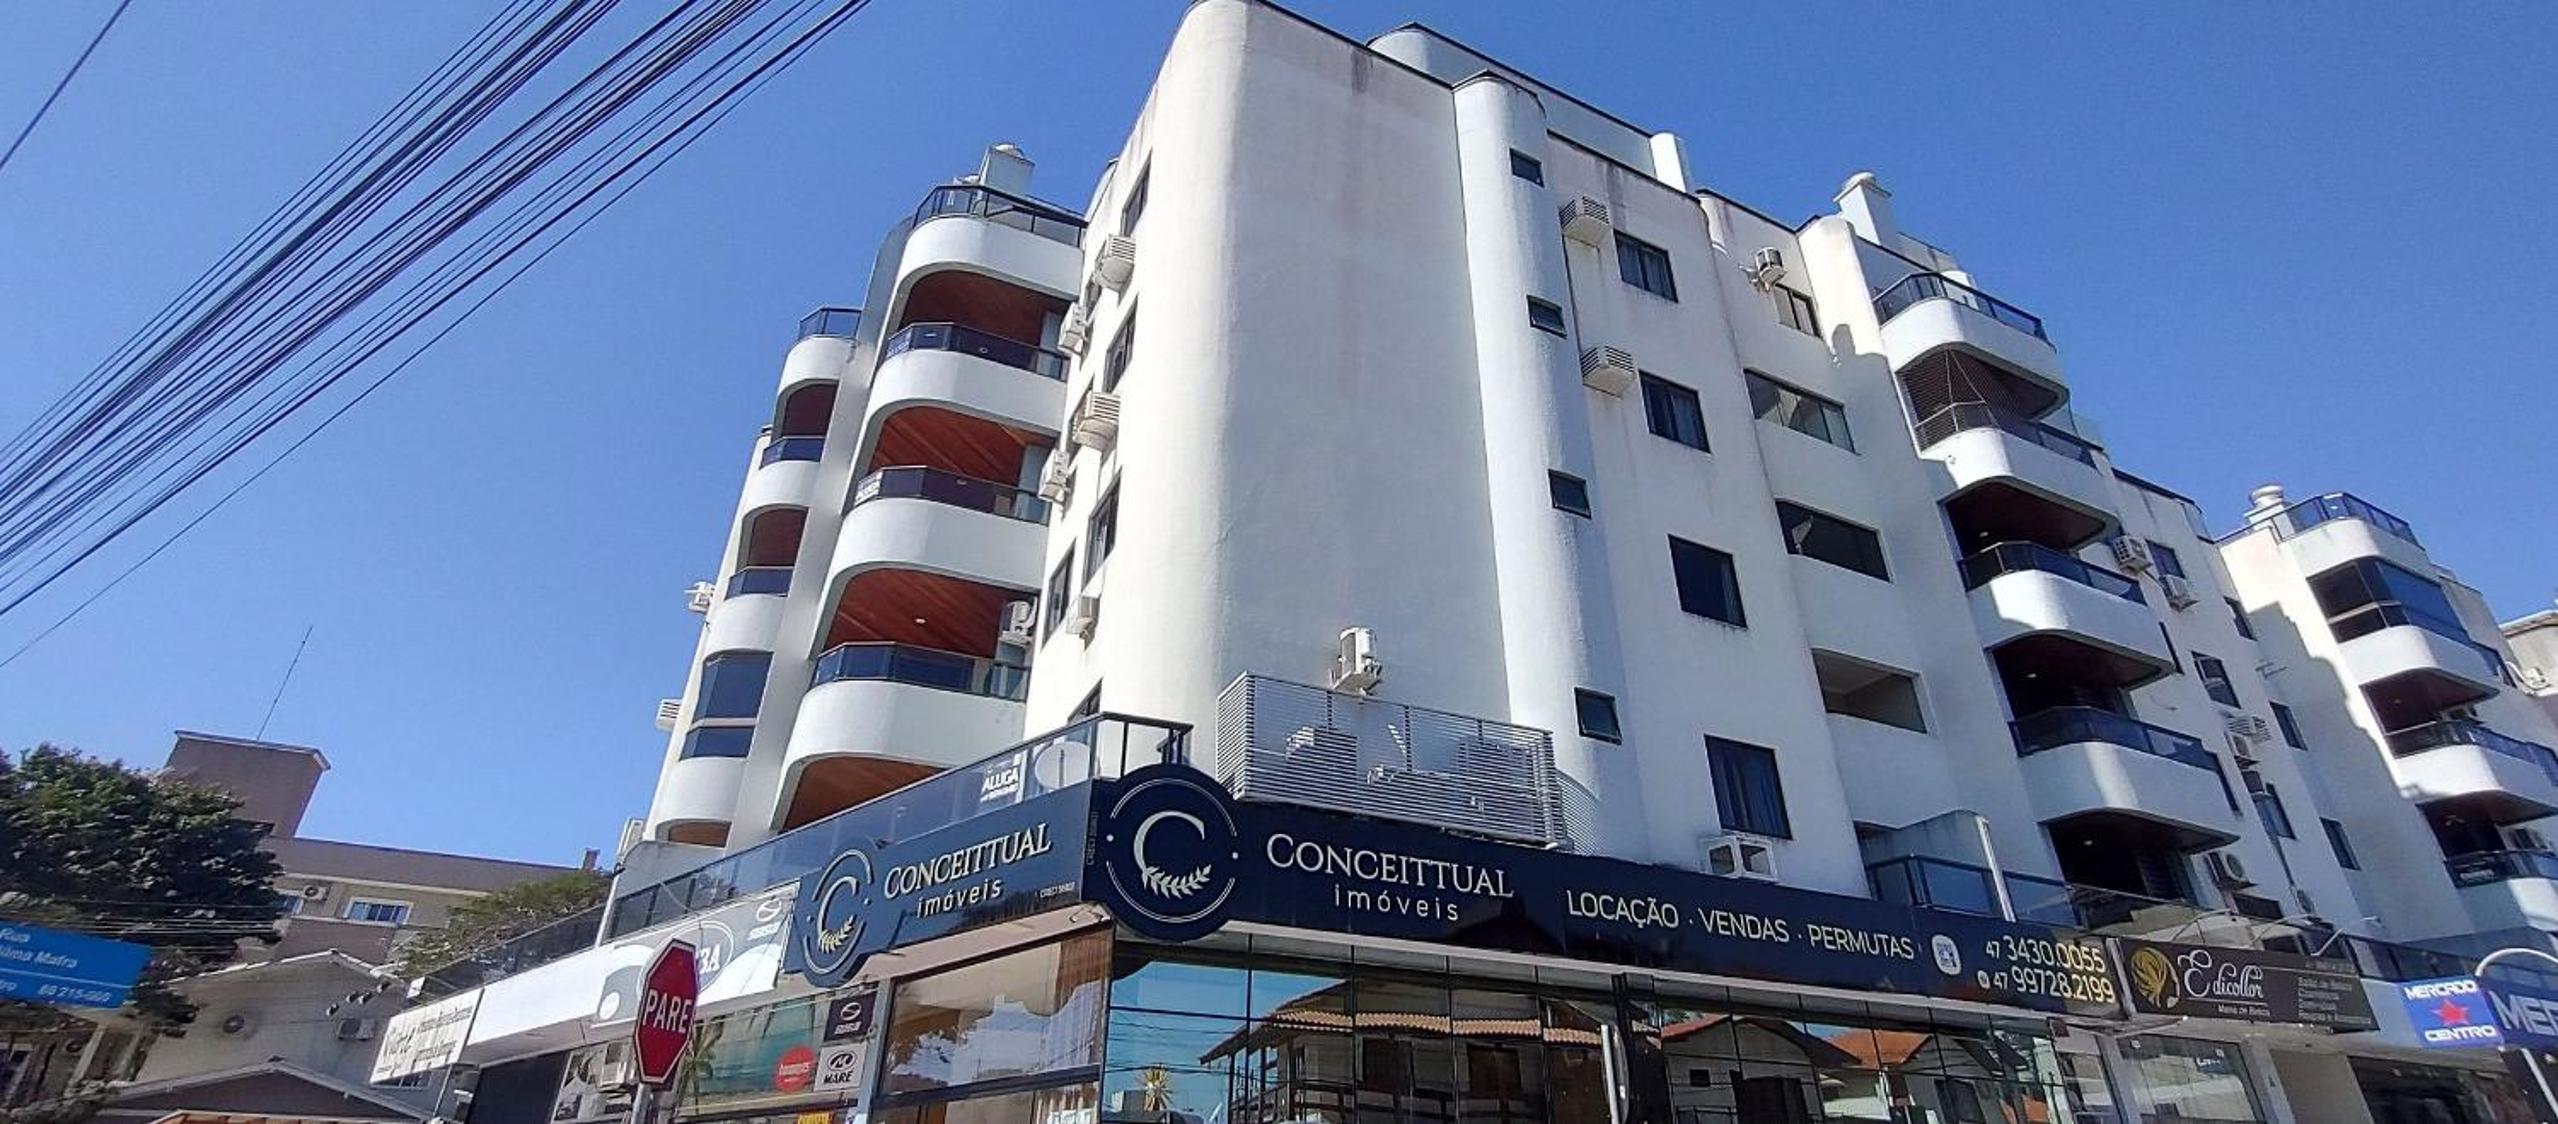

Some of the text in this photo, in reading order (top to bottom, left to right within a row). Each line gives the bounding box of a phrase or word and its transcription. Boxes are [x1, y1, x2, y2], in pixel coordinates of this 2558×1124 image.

[884, 822, 1052, 900] CONCEITTUAL
[1267, 833, 1515, 898] CONCEITTUAL
[917, 878, 1003, 918] imóveis
[1334, 883, 1460, 921] imóveis
[1566, 890, 1915, 960] LOCAÇÃO VENDAS PERMUTAS
[1985, 935, 2107, 974] 47 3430.0055
[1993, 966, 2116, 1004] 47 99728.2199
[2404, 980, 2478, 1000] MERCADO
[642, 988, 693, 1033] PARE
[2425, 1025, 2497, 1042] CENTRO
